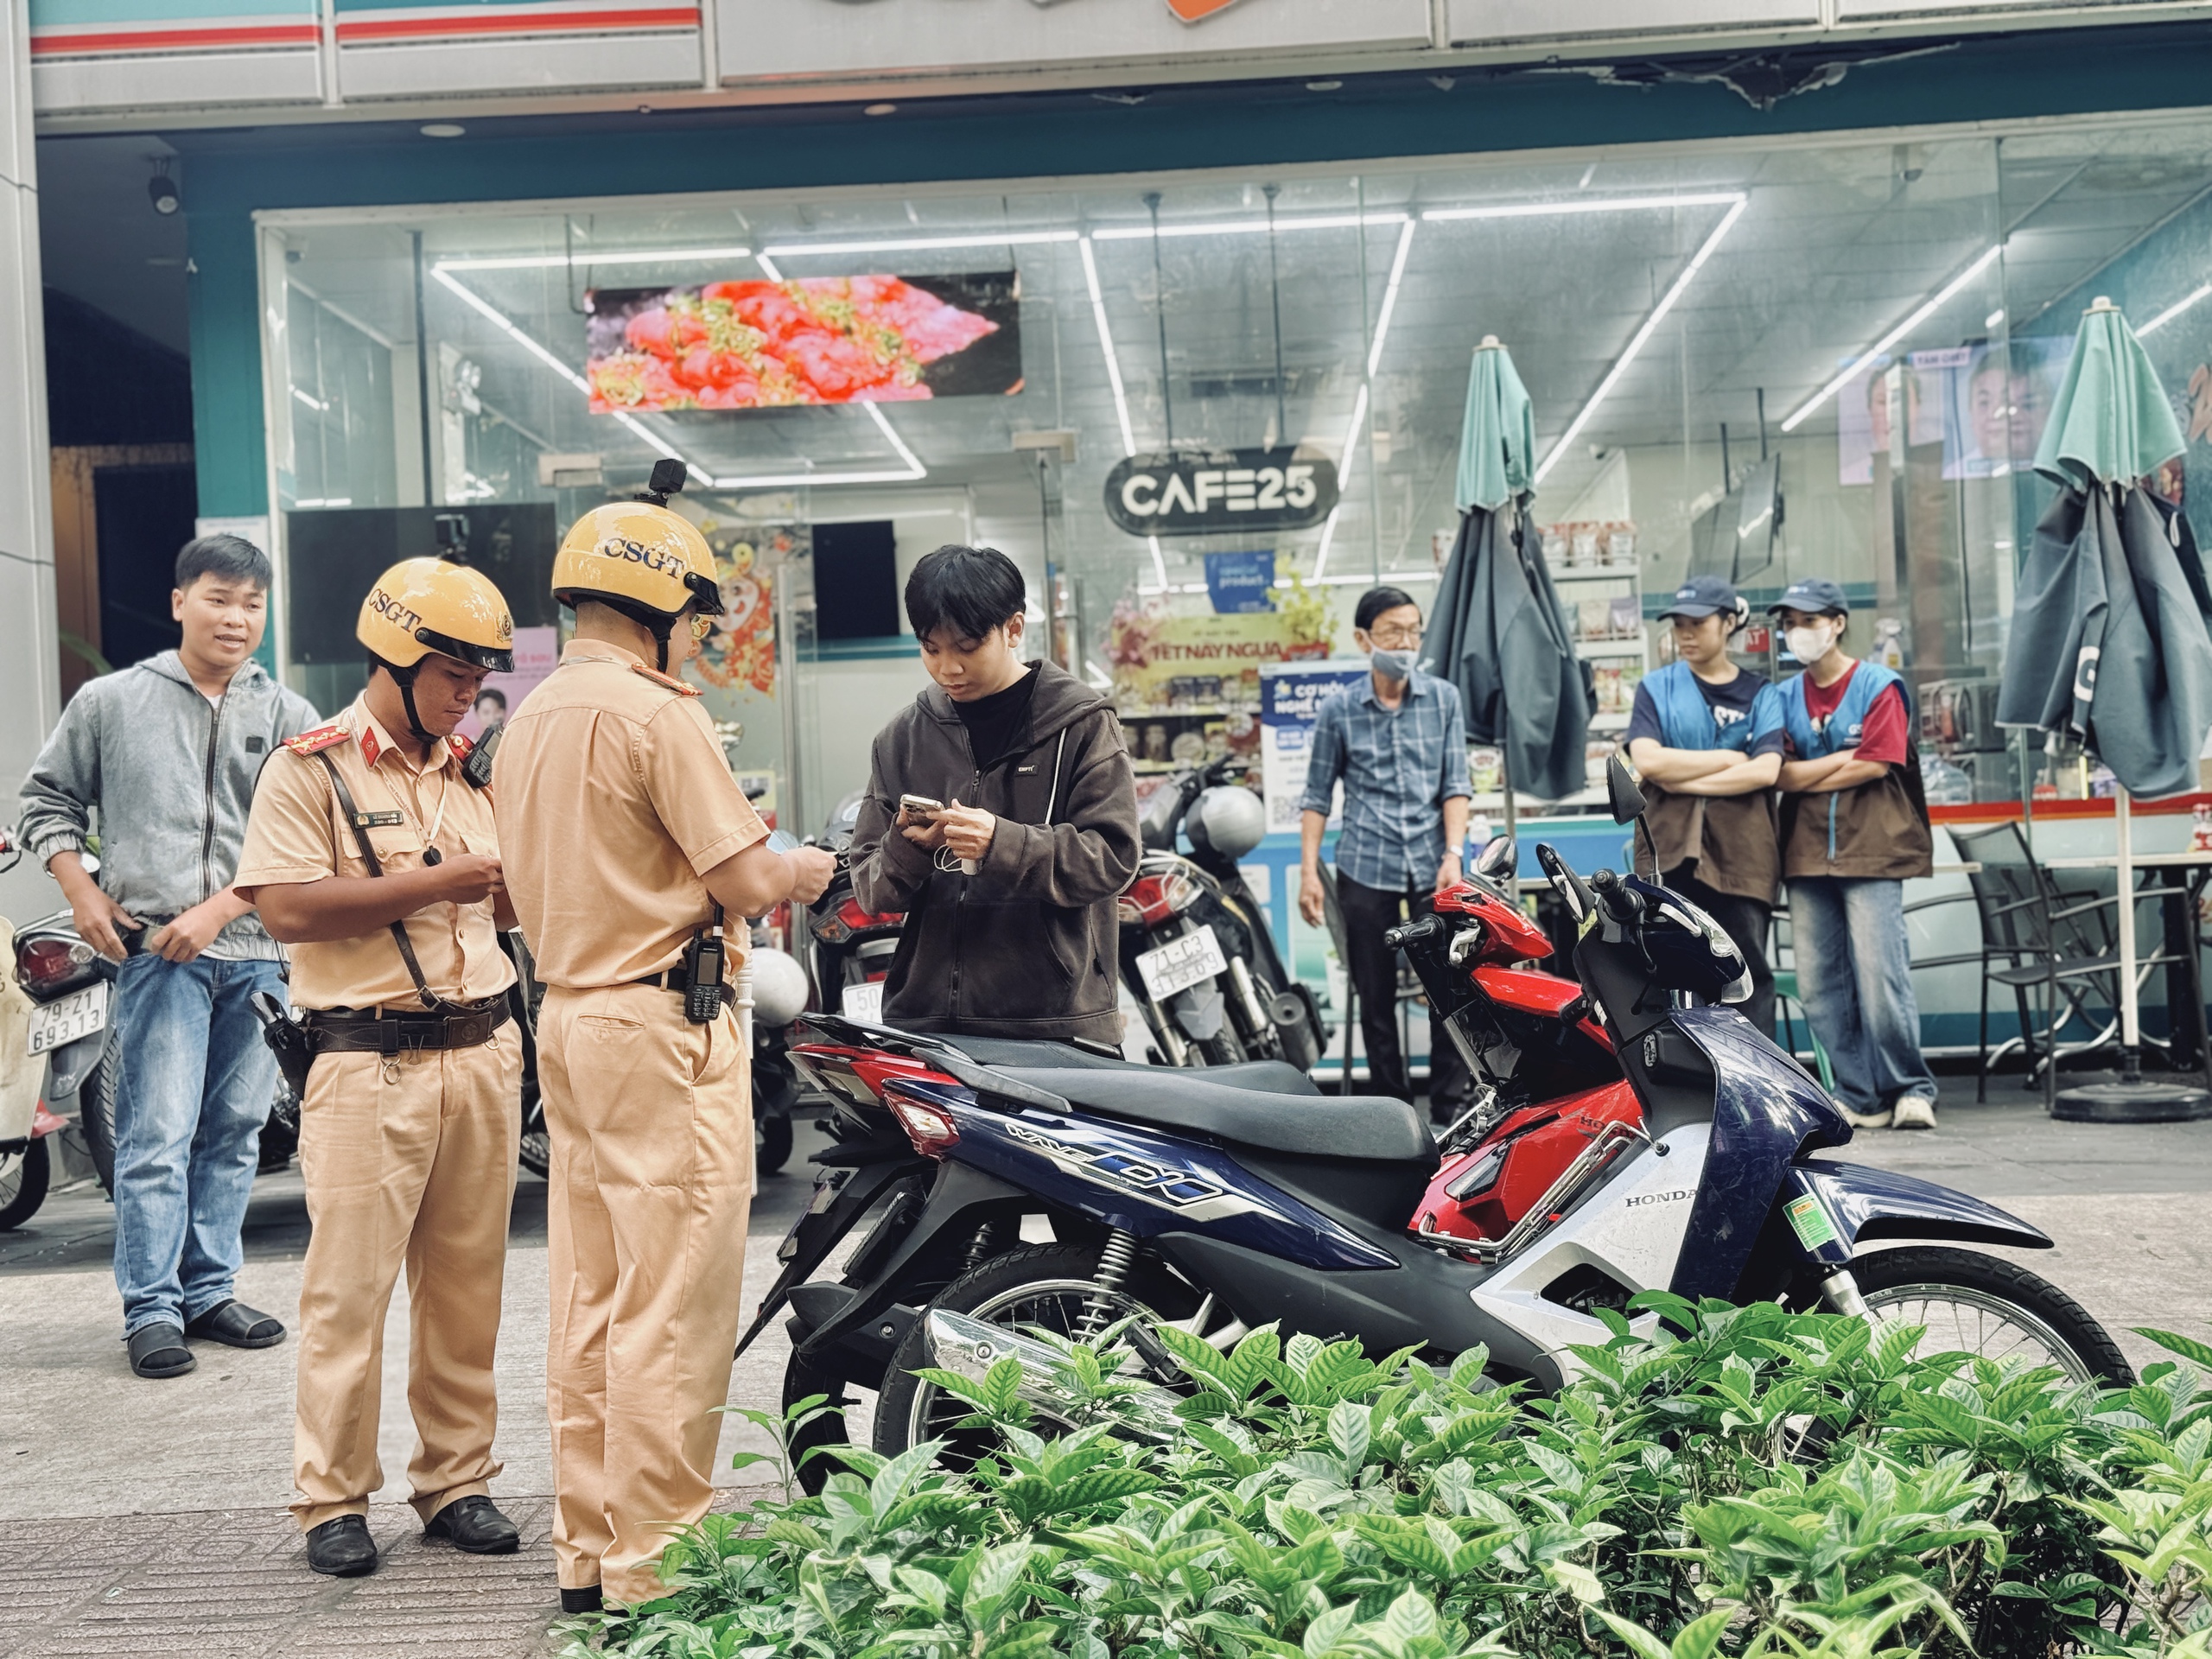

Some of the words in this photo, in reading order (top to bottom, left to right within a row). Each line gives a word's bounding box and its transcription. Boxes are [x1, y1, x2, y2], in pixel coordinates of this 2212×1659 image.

[1122, 467, 1318, 517] CAFE25
[605, 537, 684, 580] CSGT
[368, 588, 423, 632] CSGT
[33, 1008, 99, 1051] 693.13
[41, 990, 92, 1028] 79-Z1
[1625, 1189, 1700, 1208] HONDA
